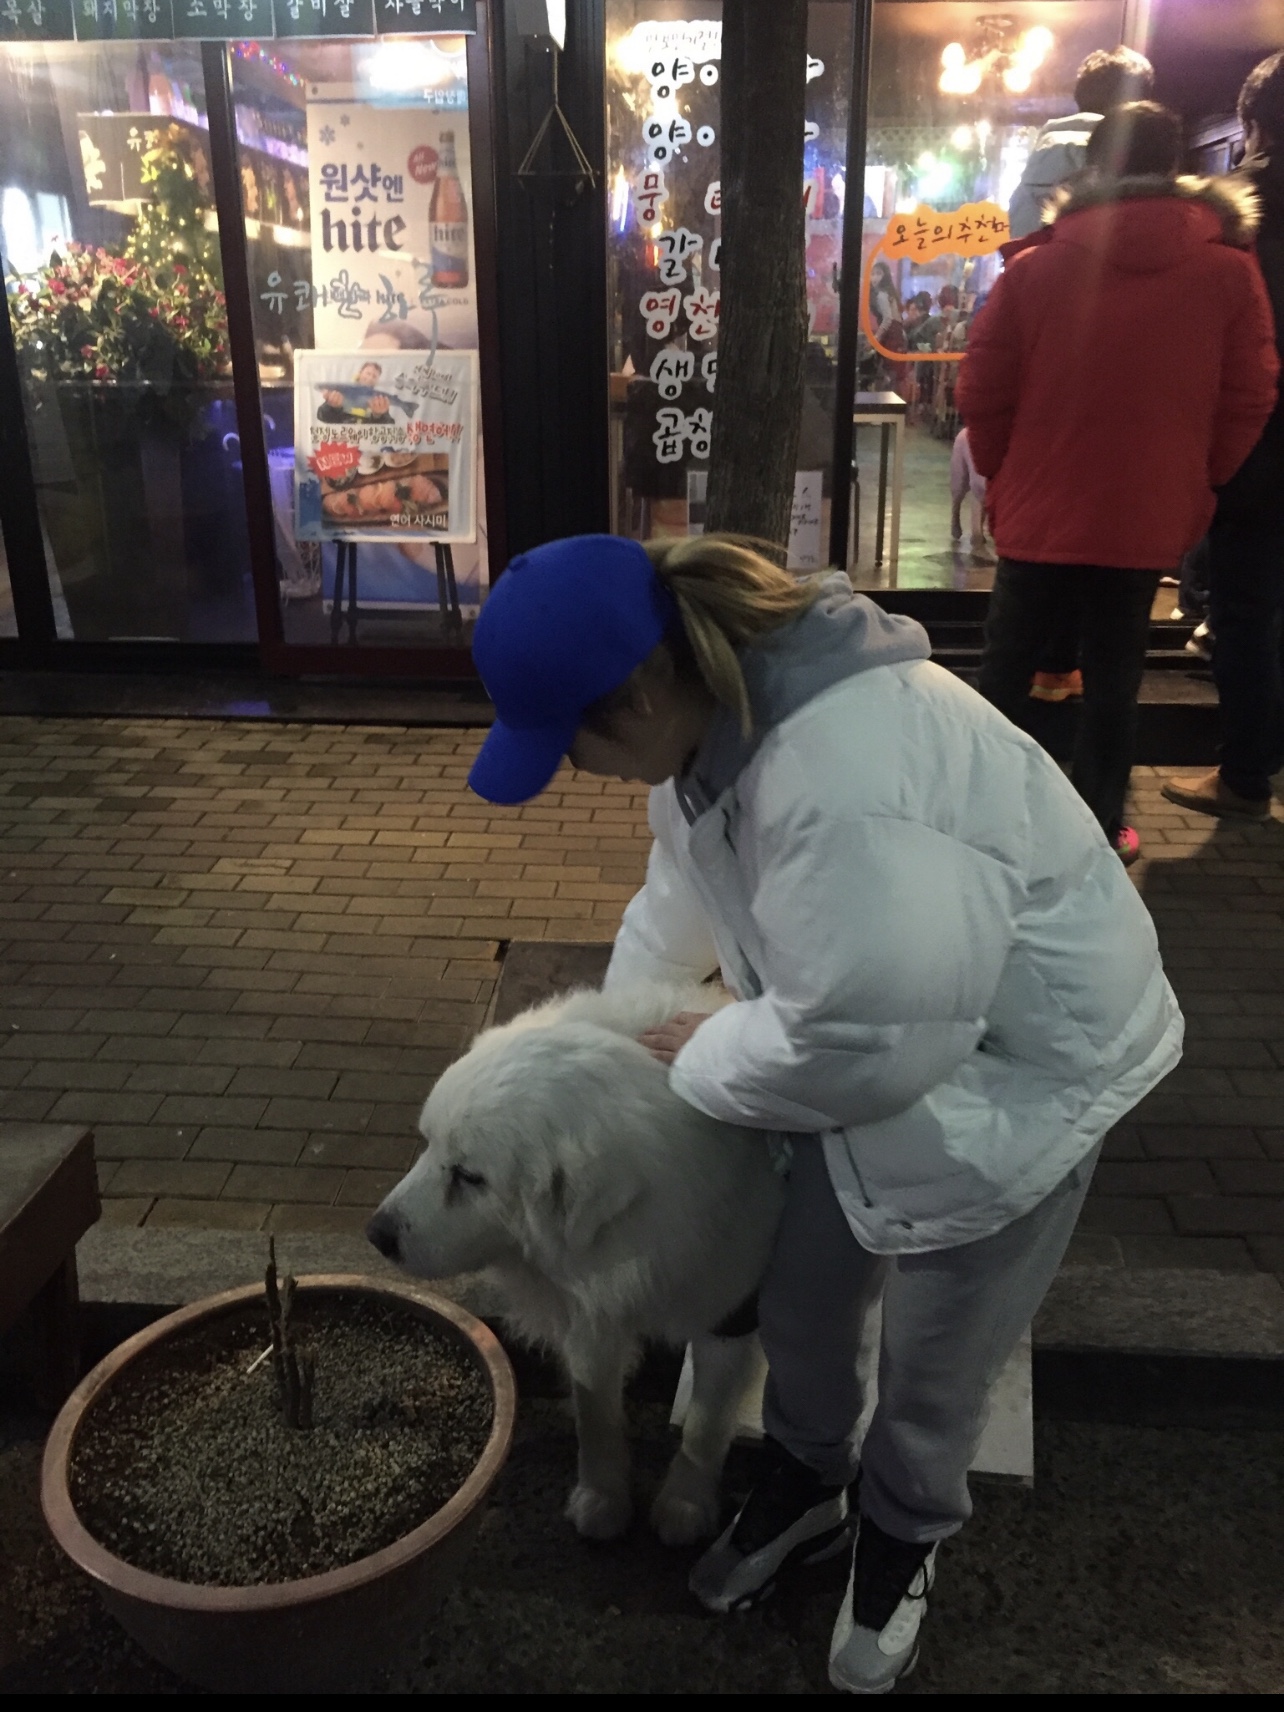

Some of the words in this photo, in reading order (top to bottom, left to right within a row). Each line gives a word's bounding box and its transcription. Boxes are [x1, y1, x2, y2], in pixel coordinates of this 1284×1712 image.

[320, 163, 404, 203] 원샷엔
[320, 206, 407, 253] hite
[893, 217, 953, 250] 오늘의
[259, 269, 362, 320] 유쾌한
[315, 452, 354, 472] NEW
[389, 513, 412, 528] 연어
[413, 513, 447, 528] 사시미
